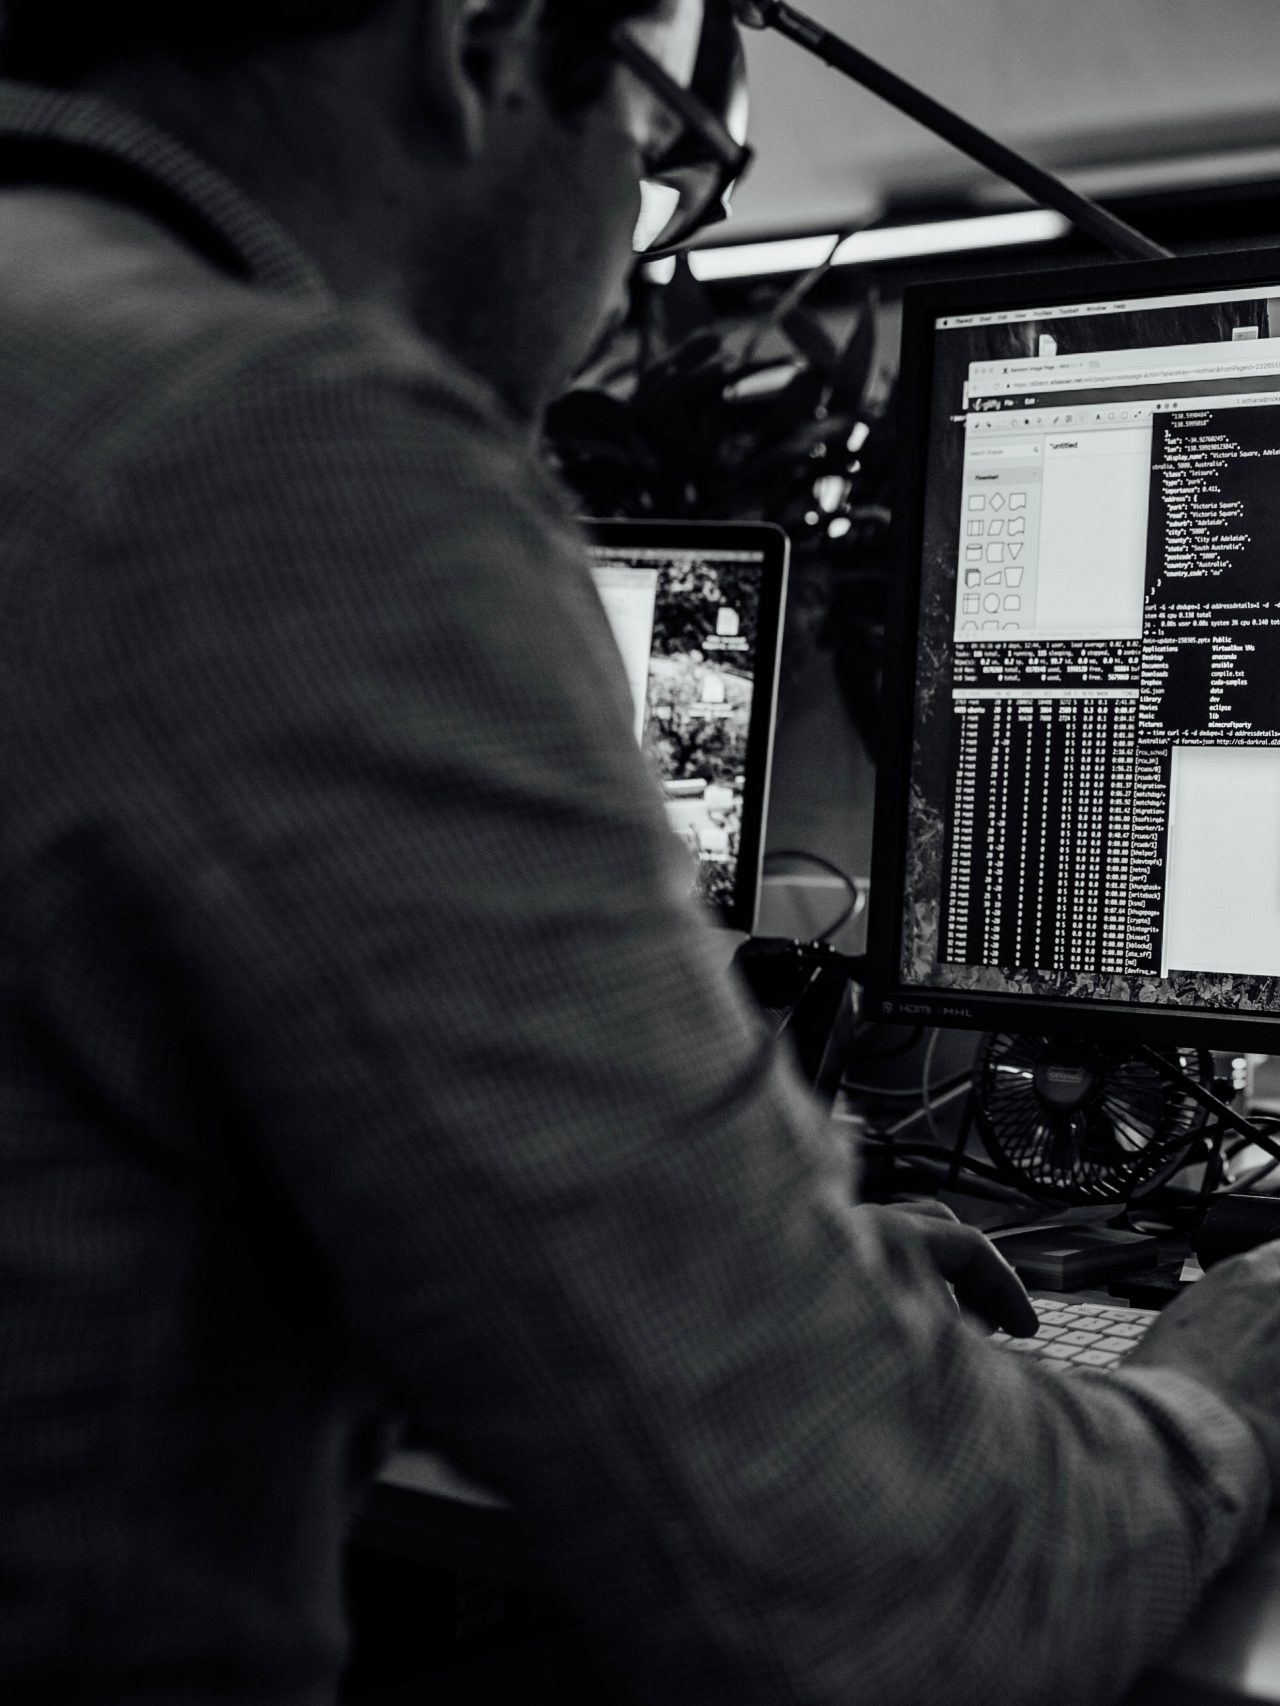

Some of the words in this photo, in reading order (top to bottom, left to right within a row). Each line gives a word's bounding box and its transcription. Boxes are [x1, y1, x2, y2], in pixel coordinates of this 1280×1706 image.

[1210, 451, 1238, 459] "Victoria
[1239, 450, 1261, 458] Square,
[1202, 485, 1221, 493] 0.411,
[1191, 544, 1210, 552] "South
[1251, 618, 1269, 626] 0.140
[1142, 645, 1179, 654] Applications
[1141, 654, 1164, 662] Desktop
[1141, 662, 1169, 670] Documents
[1210, 661, 1234, 669] ansible
[1139, 696, 1162, 704] Library
[1208, 704, 1232, 712] eclipse
[1208, 721, 1252, 729] minecraftparty
[1181, 738, 1215, 746] format=json
